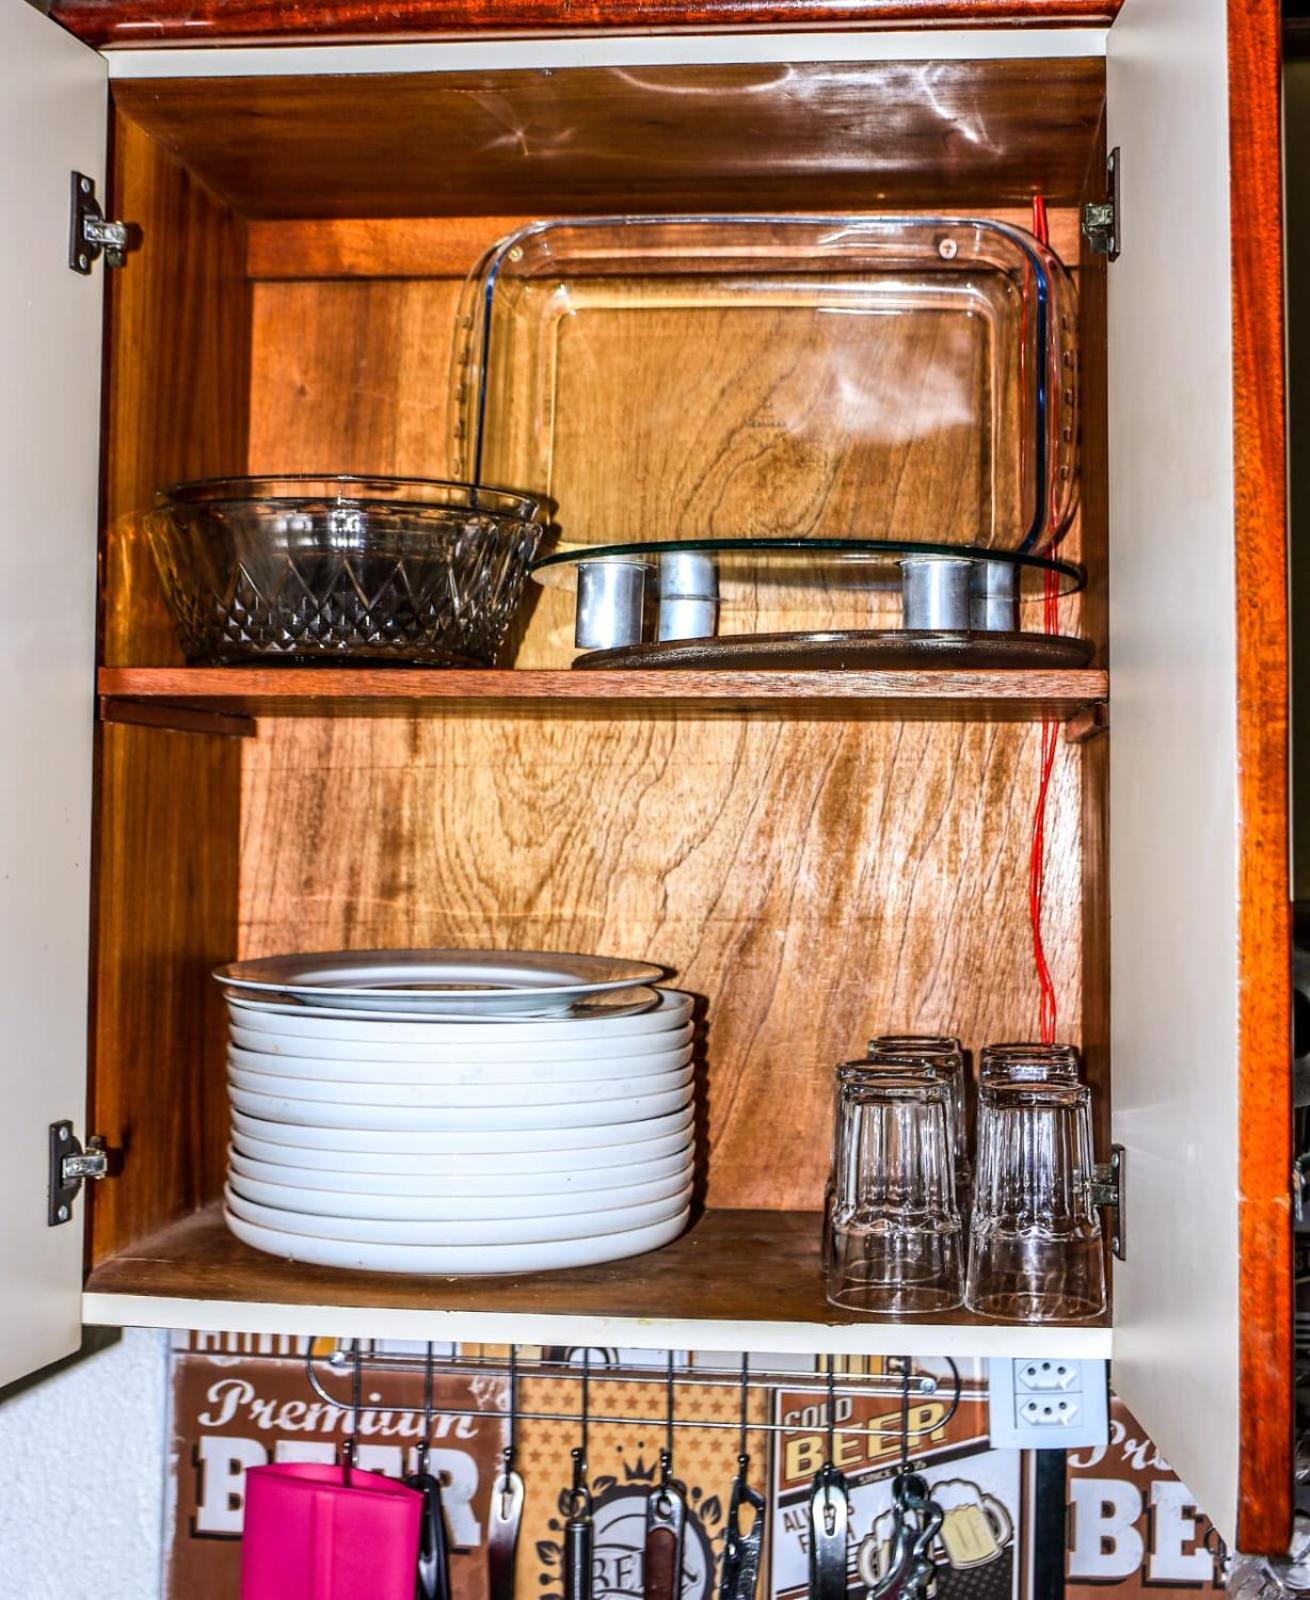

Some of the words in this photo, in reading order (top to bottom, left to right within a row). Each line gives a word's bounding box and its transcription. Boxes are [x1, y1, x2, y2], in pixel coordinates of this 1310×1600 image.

[198, 1378, 479, 1439] Premium
[784, 1397, 852, 1436] COLD
[784, 1402, 946, 1481] BEER
